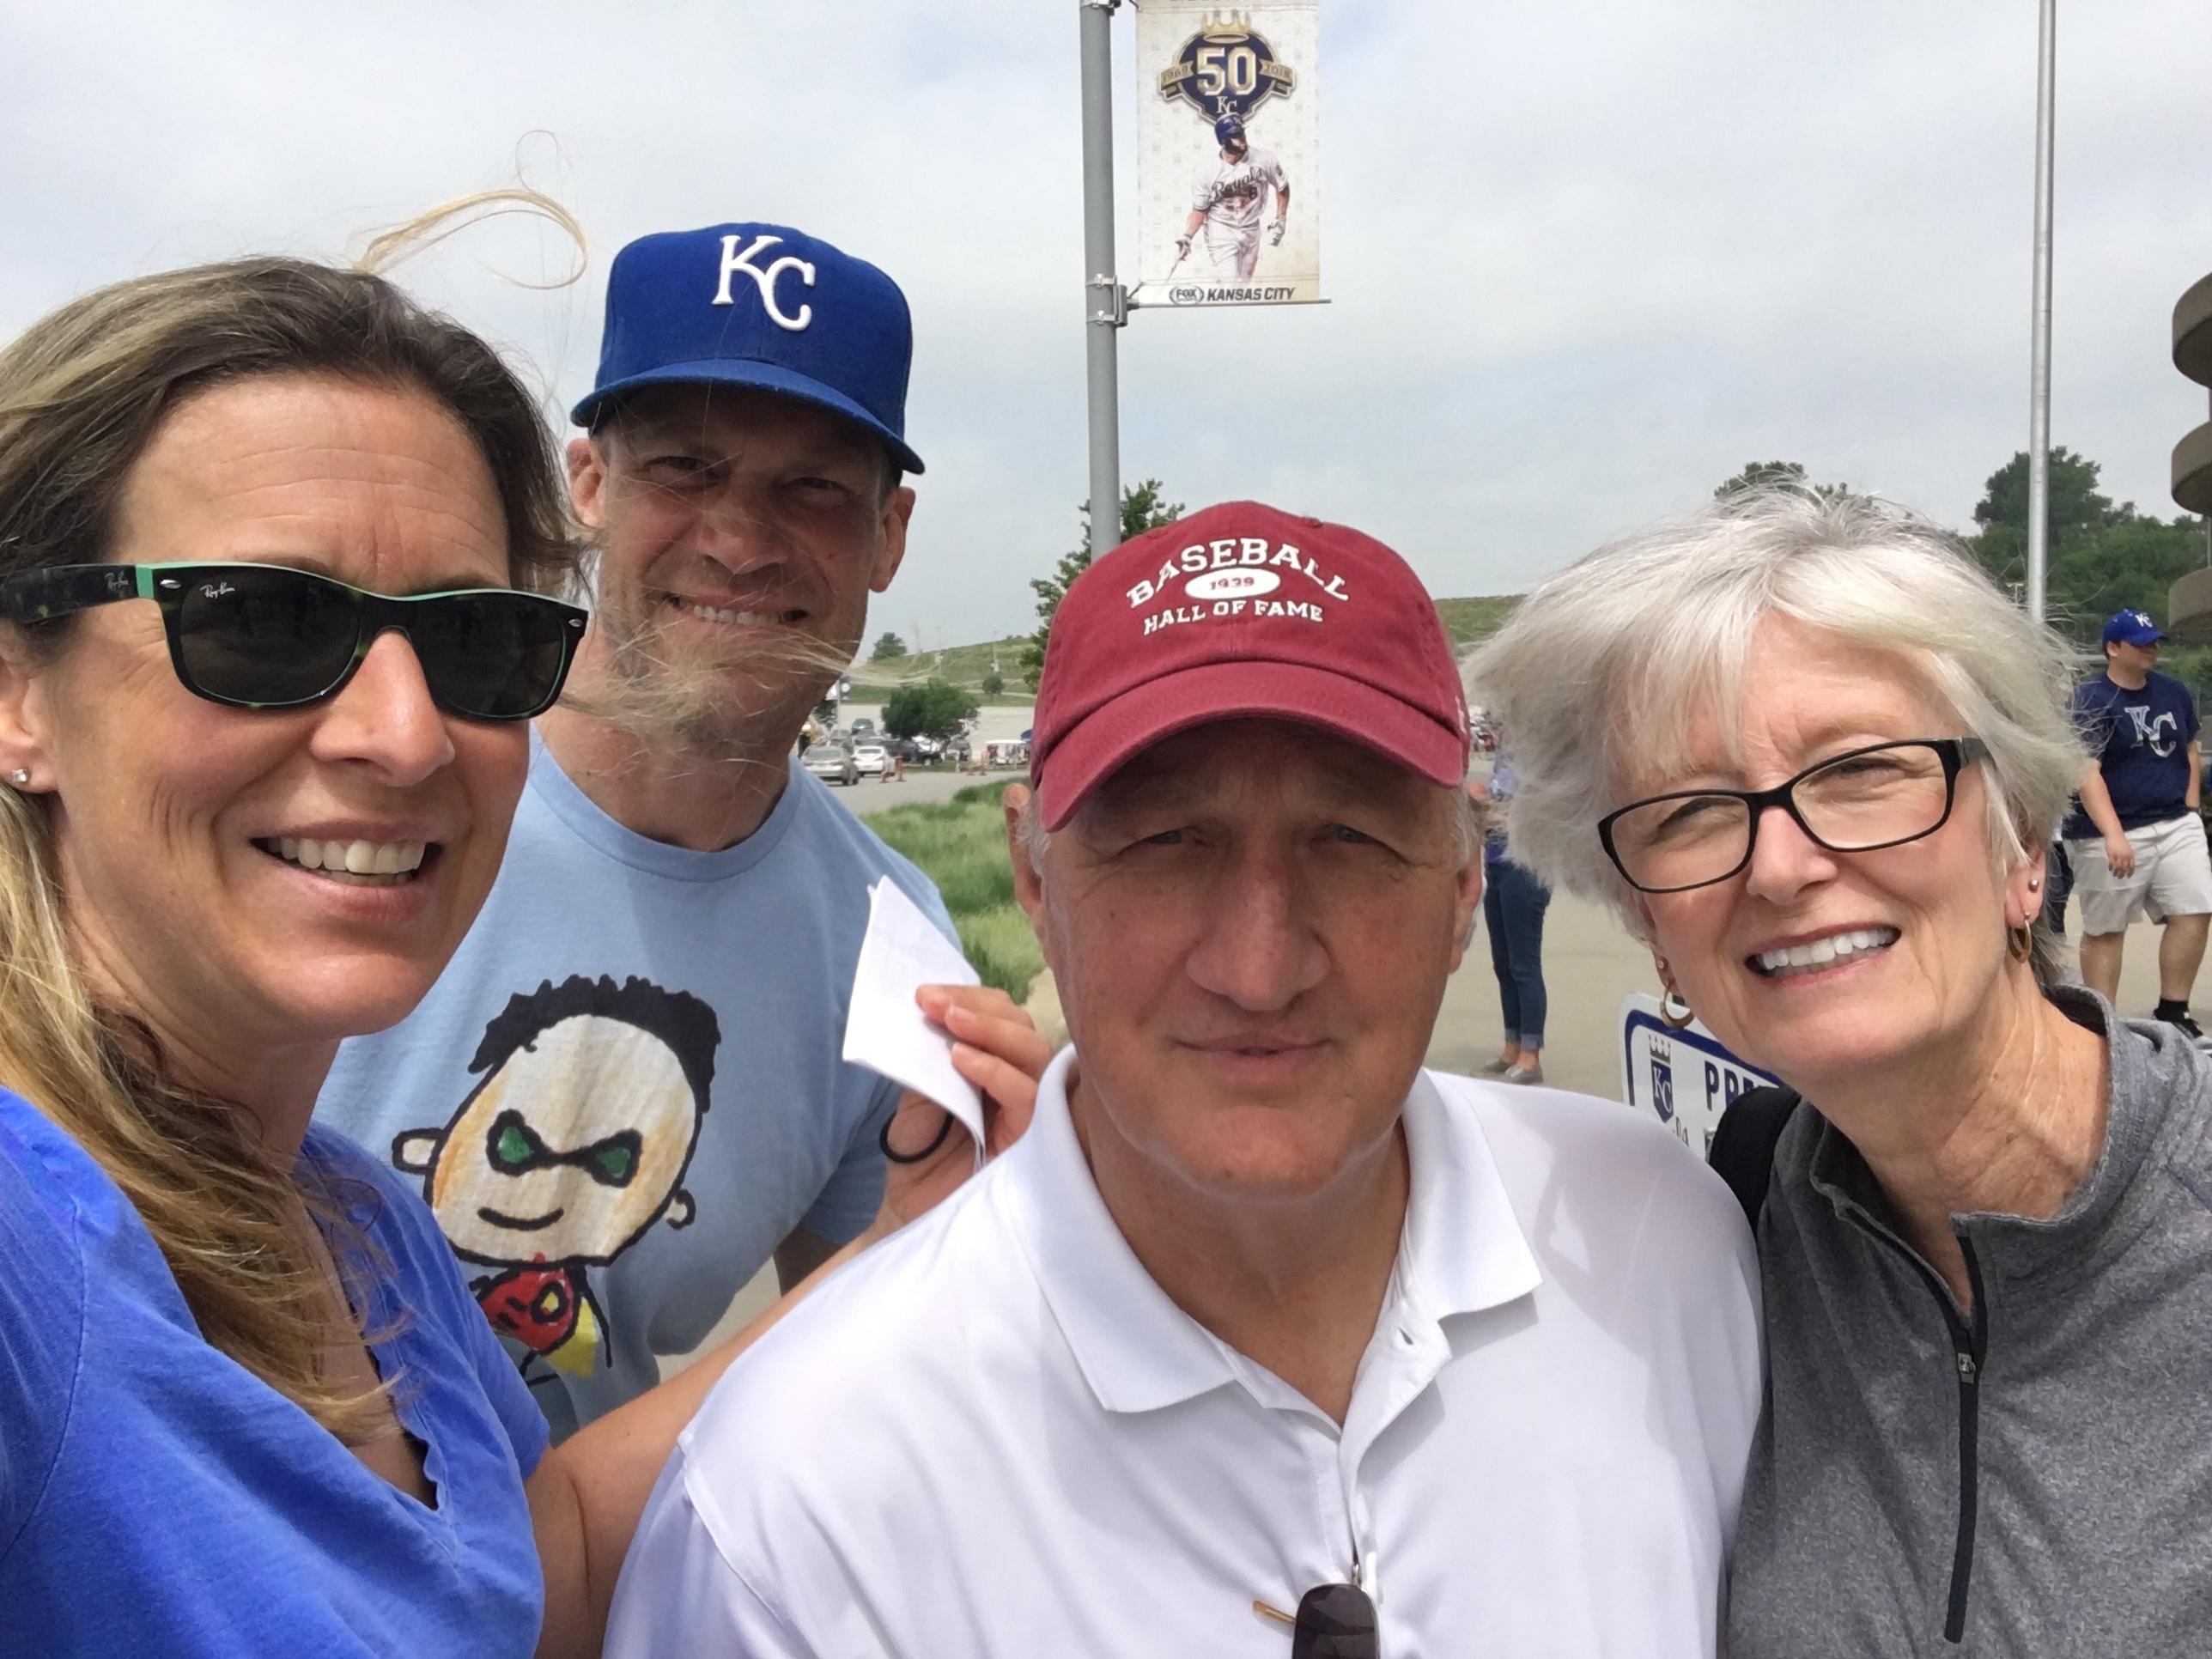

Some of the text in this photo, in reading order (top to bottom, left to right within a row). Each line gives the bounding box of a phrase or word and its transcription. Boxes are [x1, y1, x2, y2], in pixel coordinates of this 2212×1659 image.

[1197, 46, 1256, 96] 50
[1216, 95, 1238, 115] KC
[711, 234, 815, 331] KC
[1207, 288, 1262, 301] KANSAS
[1264, 287, 1297, 301] CITY
[1126, 538, 1349, 608] BASEBALL
[1209, 577, 1255, 591] 1939
[1143, 600, 1324, 635] HALL OF FAME
[2124, 705, 2178, 757] KC
[1653, 1066, 1672, 1114] KC
